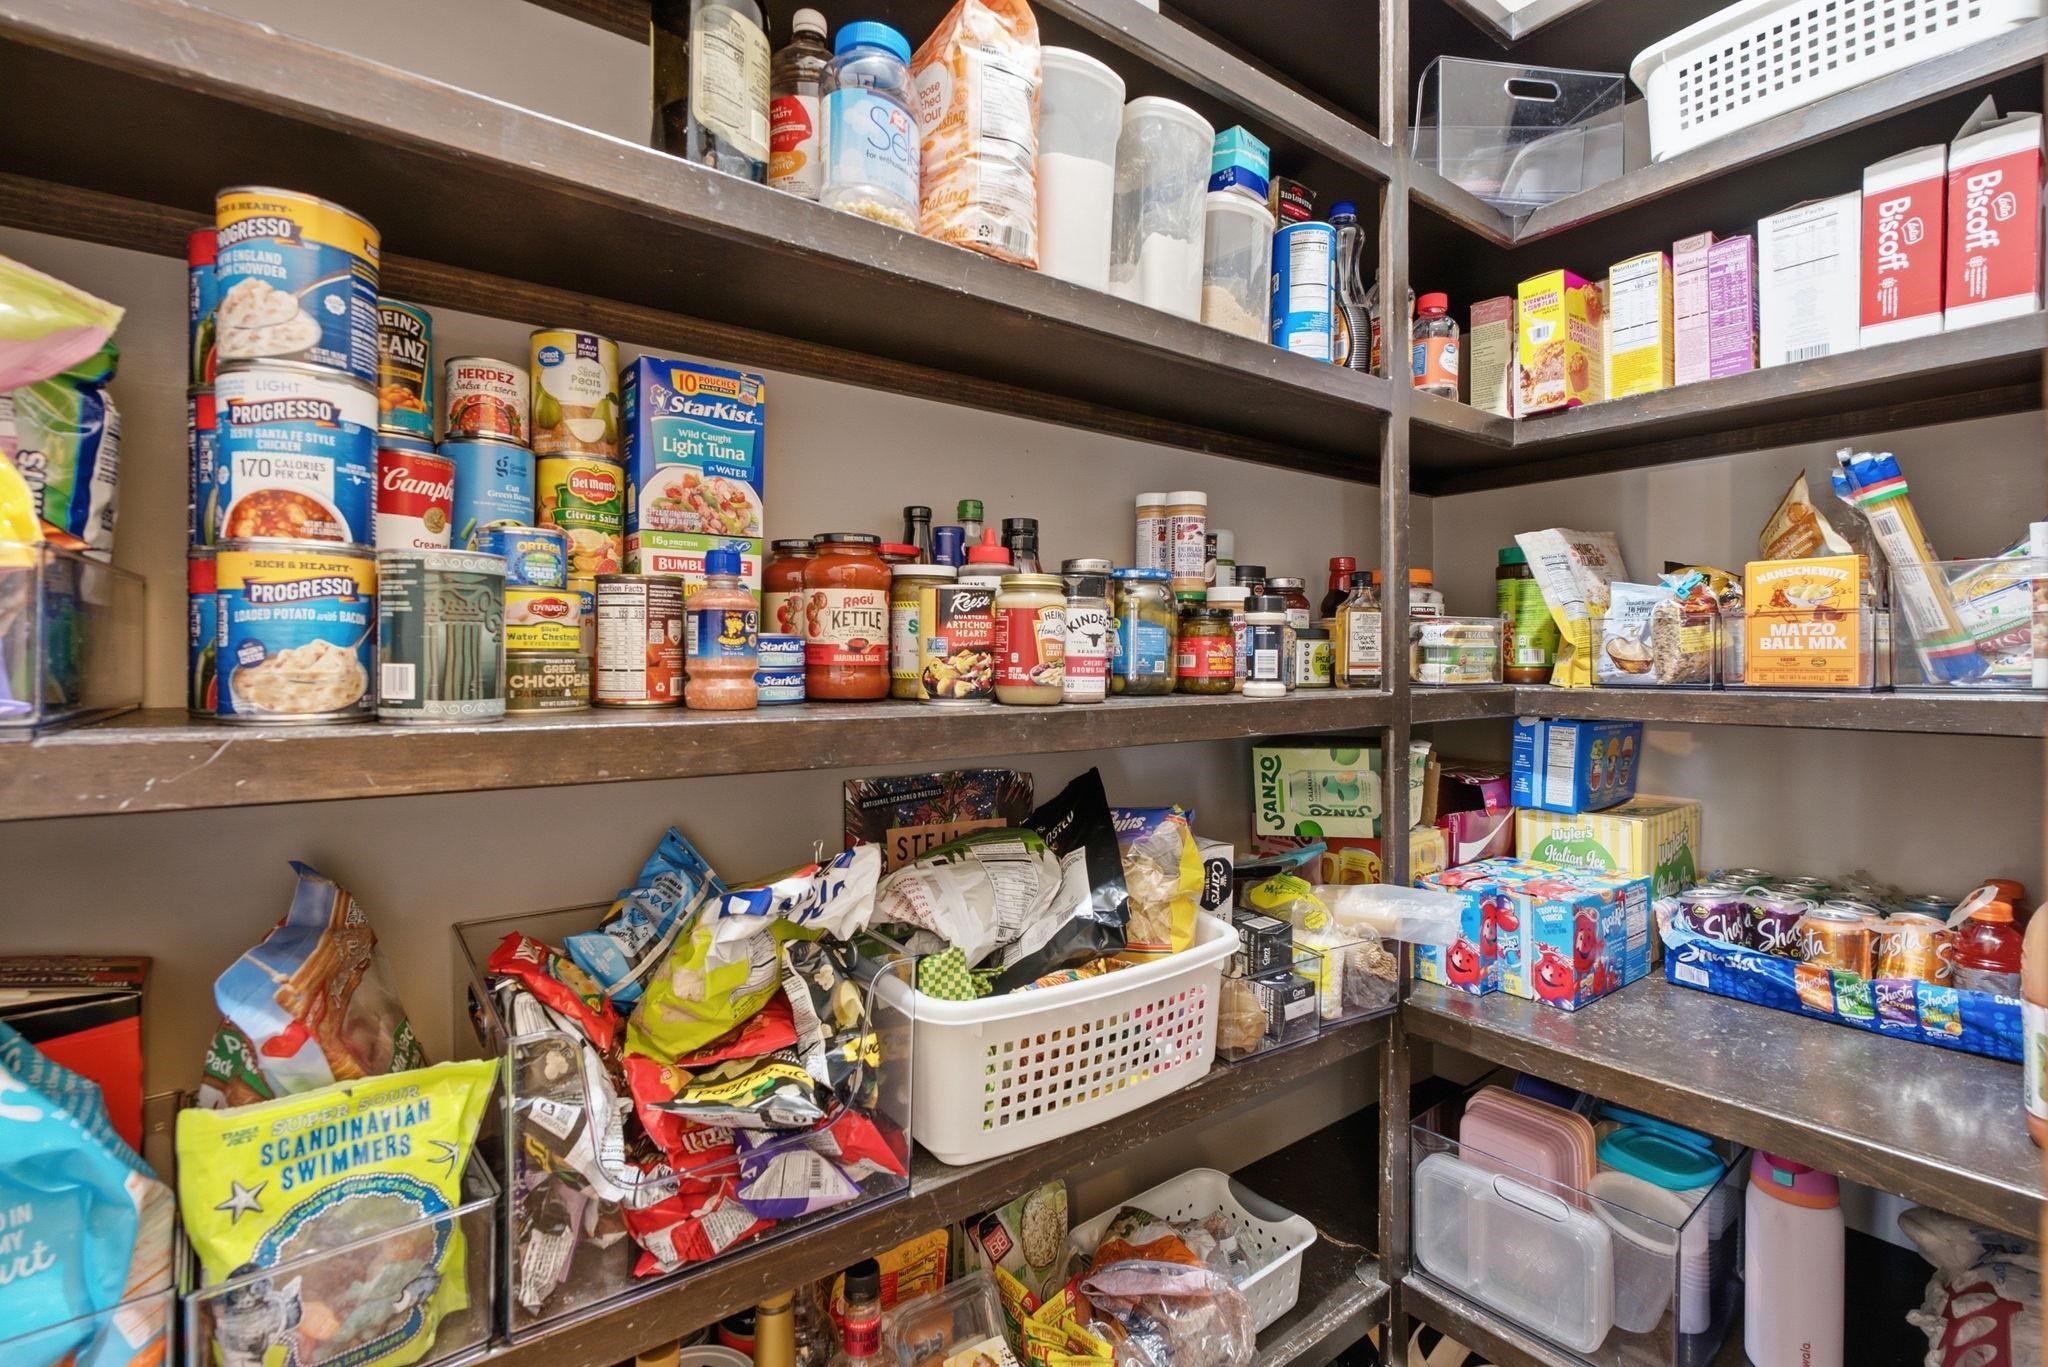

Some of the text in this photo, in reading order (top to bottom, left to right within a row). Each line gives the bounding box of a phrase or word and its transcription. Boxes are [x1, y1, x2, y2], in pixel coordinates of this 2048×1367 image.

[922, 107, 942, 124] lour
[1966, 169, 2002, 252] Biscoff
[1877, 196, 1911, 275] Biscoff
[233, 249, 282, 266] ENGLAND
[234, 265, 287, 280] CHOWDER
[255, 379, 300, 393] LIGHT
[457, 367, 516, 386] HERDEZ
[680, 373, 737, 392] 10 POUCHES
[454, 381, 481, 392] Salsa
[231, 400, 332, 424] PROGRESSO
[669, 396, 755, 425] StarKist
[255, 428, 287, 441] SANTA
[305, 434, 336, 447] STYLE
[257, 440, 301, 452] CHICKEN
[678, 428, 732, 445] Wild Caught
[662, 436, 745, 461] Light Tuna
[240, 458, 326, 478] 170 CALORIES
[274, 470, 319, 481] PER CAN
[716, 464, 748, 479] WATER
[383, 467, 454, 502] Campb
[572, 478, 616, 492] Del Monte
[565, 510, 596, 520] Citrus
[254, 560, 285, 569] RICH
[300, 562, 351, 572] HEARTY
[658, 557, 705, 572] BUMBL
[1756, 565, 1849, 585] MANISCHEWITZ
[251, 578, 352, 603] PROGRESSO
[624, 584, 644, 593] Facts
[234, 608, 271, 623] LOADED
[273, 608, 315, 621] POTATO
[831, 610, 882, 631] KETTLE
[1066, 613, 1106, 633] KINDE
[507, 632, 538, 641] Water
[956, 630, 988, 638] HEARTS
[1770, 622, 1836, 638] MATZO
[1760, 637, 1847, 651] BALL MIX
[543, 664, 576, 674] GREEK
[862, 798, 889, 809] ARTISANAL
[918, 788, 943, 800] PRETZELS
[1260, 754, 1286, 831] SANZO
[1308, 803, 1373, 819] SANZO
[1551, 825, 1594, 844] Wyler's
[1544, 844, 1606, 869] Italian Ice
[1757, 918, 1802, 952] Shas
[1834, 977, 1870, 996] Shasta
[1875, 984, 1914, 1005] Shasta
[1917, 989, 1959, 1008] Shasta
[272, 1085, 420, 1136] SUPER SOUR
[261, 1096, 431, 1167] SCANDINAVIAN
[281, 1133, 412, 1190] SWIMMERS
[342, 1180, 385, 1194] GUMMY
[386, 1180, 428, 1199] CANDIES
[1799, 1342, 1811, 1367] wala
